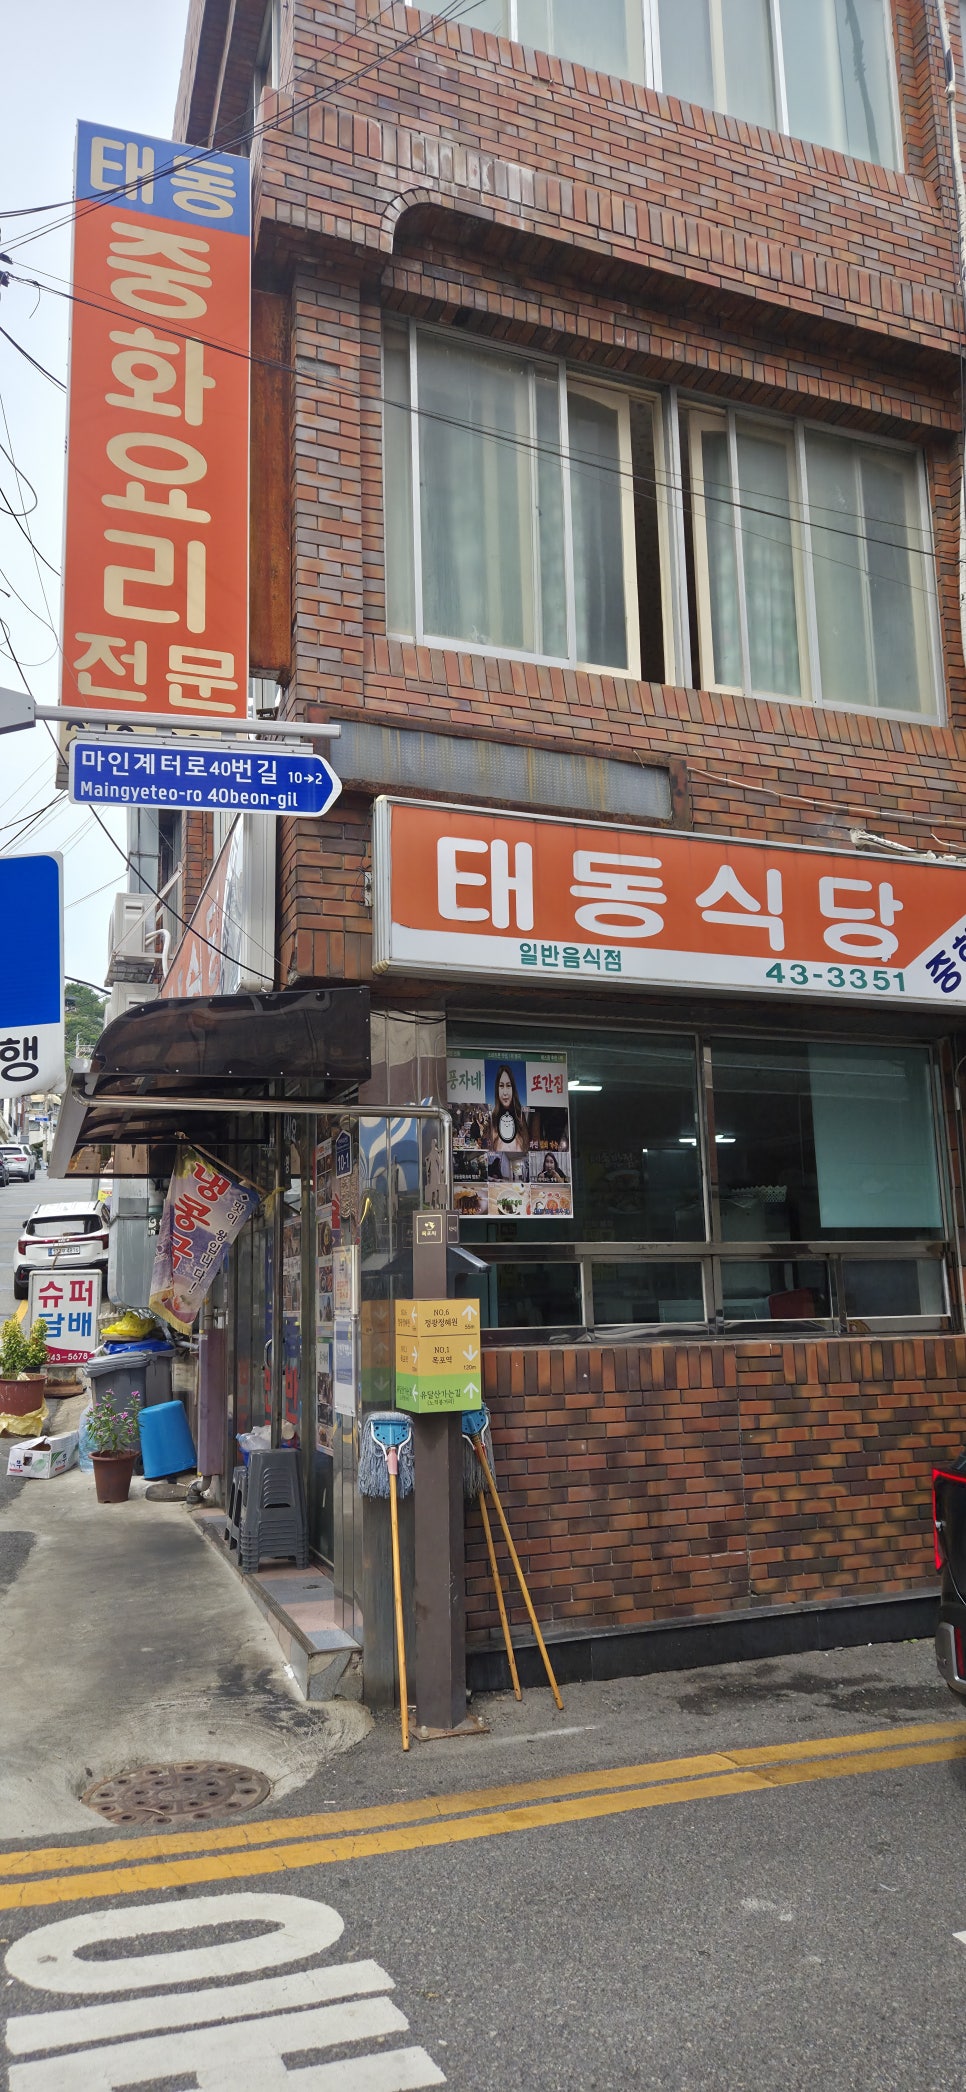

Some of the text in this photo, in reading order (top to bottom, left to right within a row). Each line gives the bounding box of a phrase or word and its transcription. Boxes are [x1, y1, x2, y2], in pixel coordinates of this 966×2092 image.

[89, 135, 237, 219] 태동
[101, 220, 216, 634] 중화요리
[72, 630, 238, 713] 전문
[81, 750, 277, 785] 마인계터로40번길
[288, 771, 323, 785] 10 2
[80, 780, 298, 809] Maingyeteo-ro 40beon-gil
[436, 836, 904, 962] 태동식당
[519, 942, 622, 973] 일반음식점
[765, 962, 906, 992] 43-3351
[447, 1069, 482, 1092] 풍자네
[530, 1072, 564, 1094] 또간집
[337, 1152, 350, 1173] 10-1
[38, 1280, 94, 1309] 슈퍼
[38, 1312, 93, 1338] 담배
